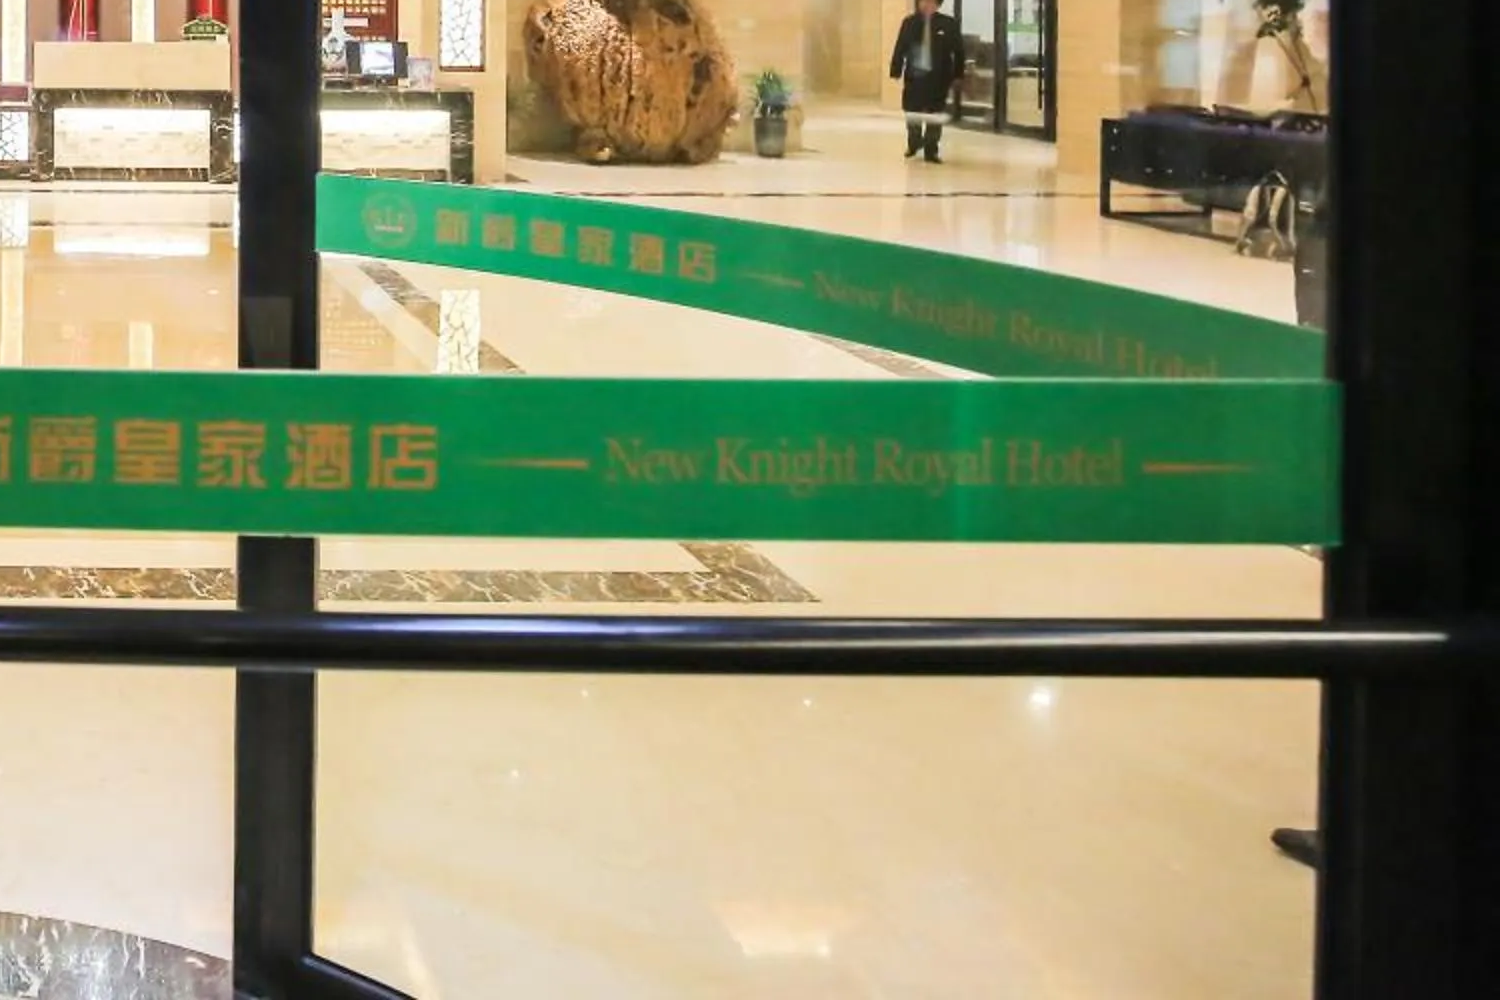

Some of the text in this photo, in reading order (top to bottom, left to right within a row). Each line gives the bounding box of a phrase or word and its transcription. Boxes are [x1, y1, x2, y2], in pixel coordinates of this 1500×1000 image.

[890, 284, 997, 341] Knight
[602, 436, 1126, 498] New Knight Royal Hotel
